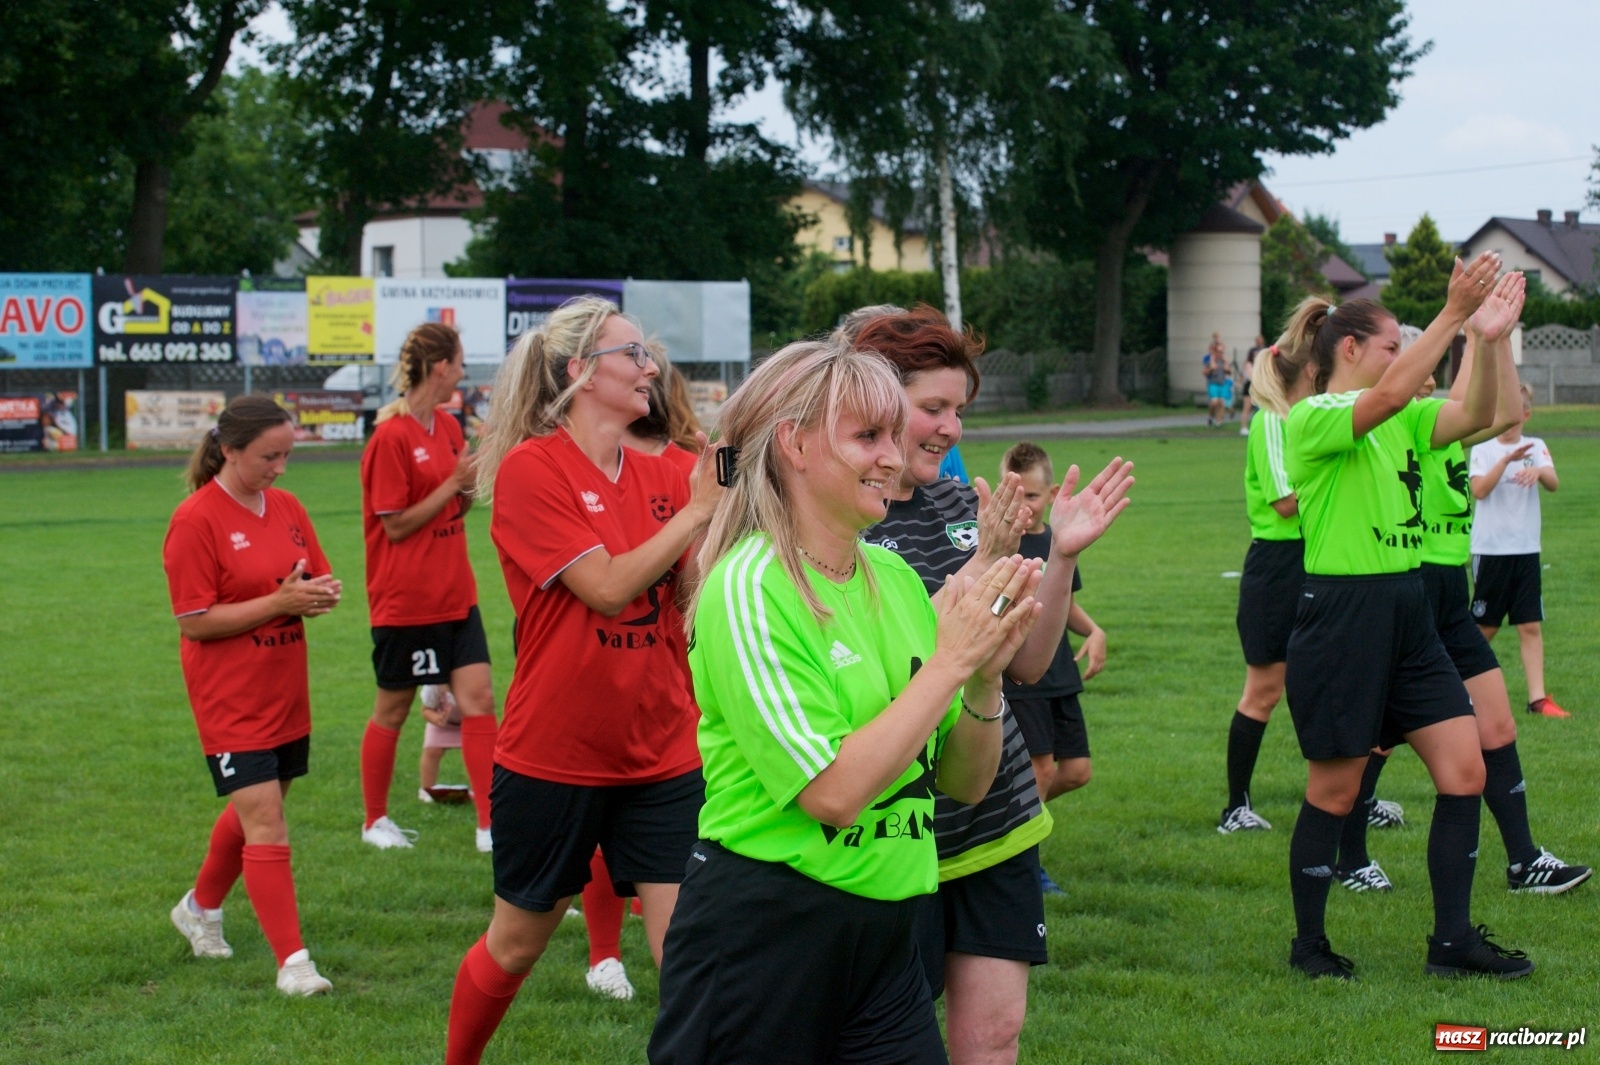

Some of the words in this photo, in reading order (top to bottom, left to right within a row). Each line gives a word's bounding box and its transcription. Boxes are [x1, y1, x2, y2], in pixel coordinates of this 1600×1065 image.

[381, 285, 417, 298] GMINA
[0, 297, 84, 333] AVO
[191, 321, 201, 334] A
[223, 321, 232, 334] Z
[99, 342, 127, 361] tel.
[129, 342, 162, 361] 665
[164, 342, 198, 361] 092
[200, 342, 232, 361] 363
[1371, 526, 1398, 548] Va
[596, 627, 622, 648] Va
[411, 648, 440, 676] 21
[832, 653, 862, 670] adidas
[216, 752, 236, 778] 2
[820, 822, 864, 847] Va
